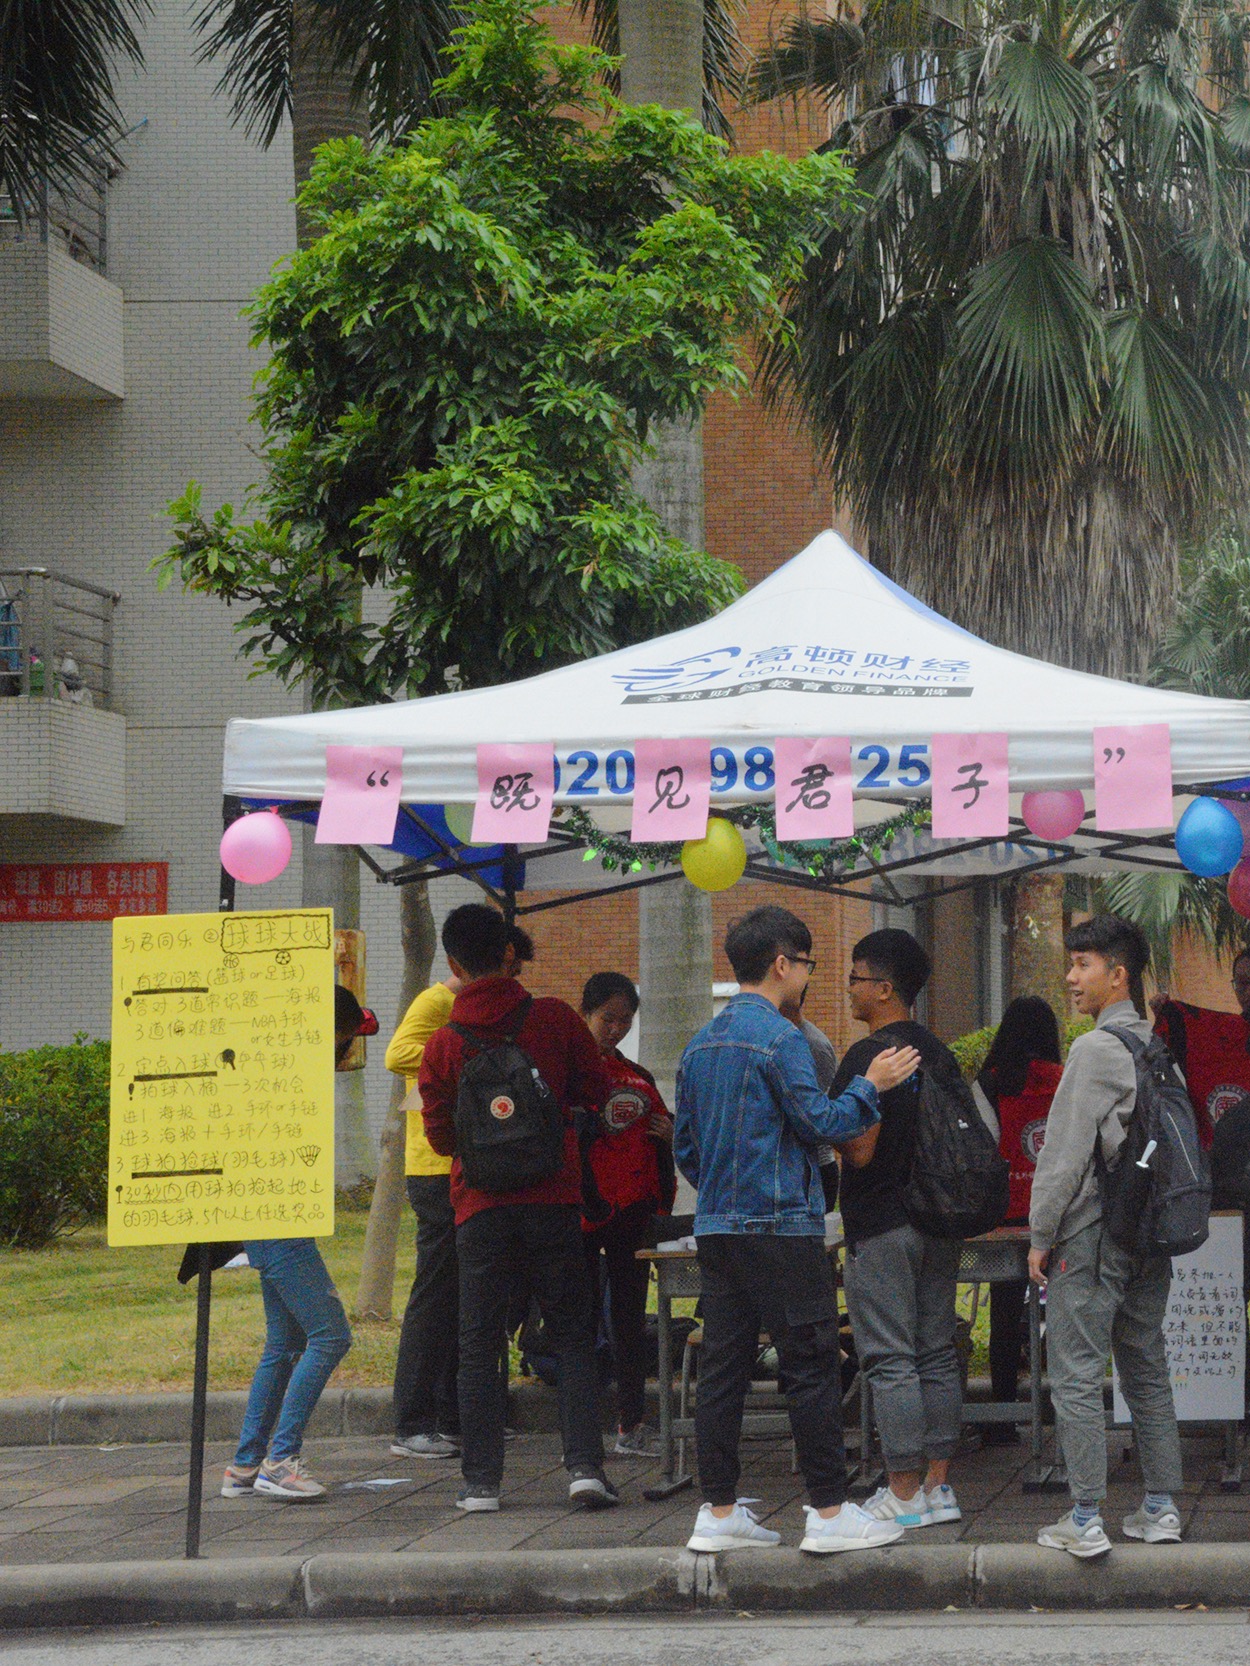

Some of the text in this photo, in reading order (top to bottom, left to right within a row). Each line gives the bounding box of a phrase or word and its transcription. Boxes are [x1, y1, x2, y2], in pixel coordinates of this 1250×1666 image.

[744, 645, 972, 674] 高顿财经
[738, 664, 968, 683] GOLDEN FINANCE
[646, 679, 949, 704] 全球财经教育领导品牌
[121, 929, 193, 954] 与君同乐
[226, 918, 326, 949] 球球大战
